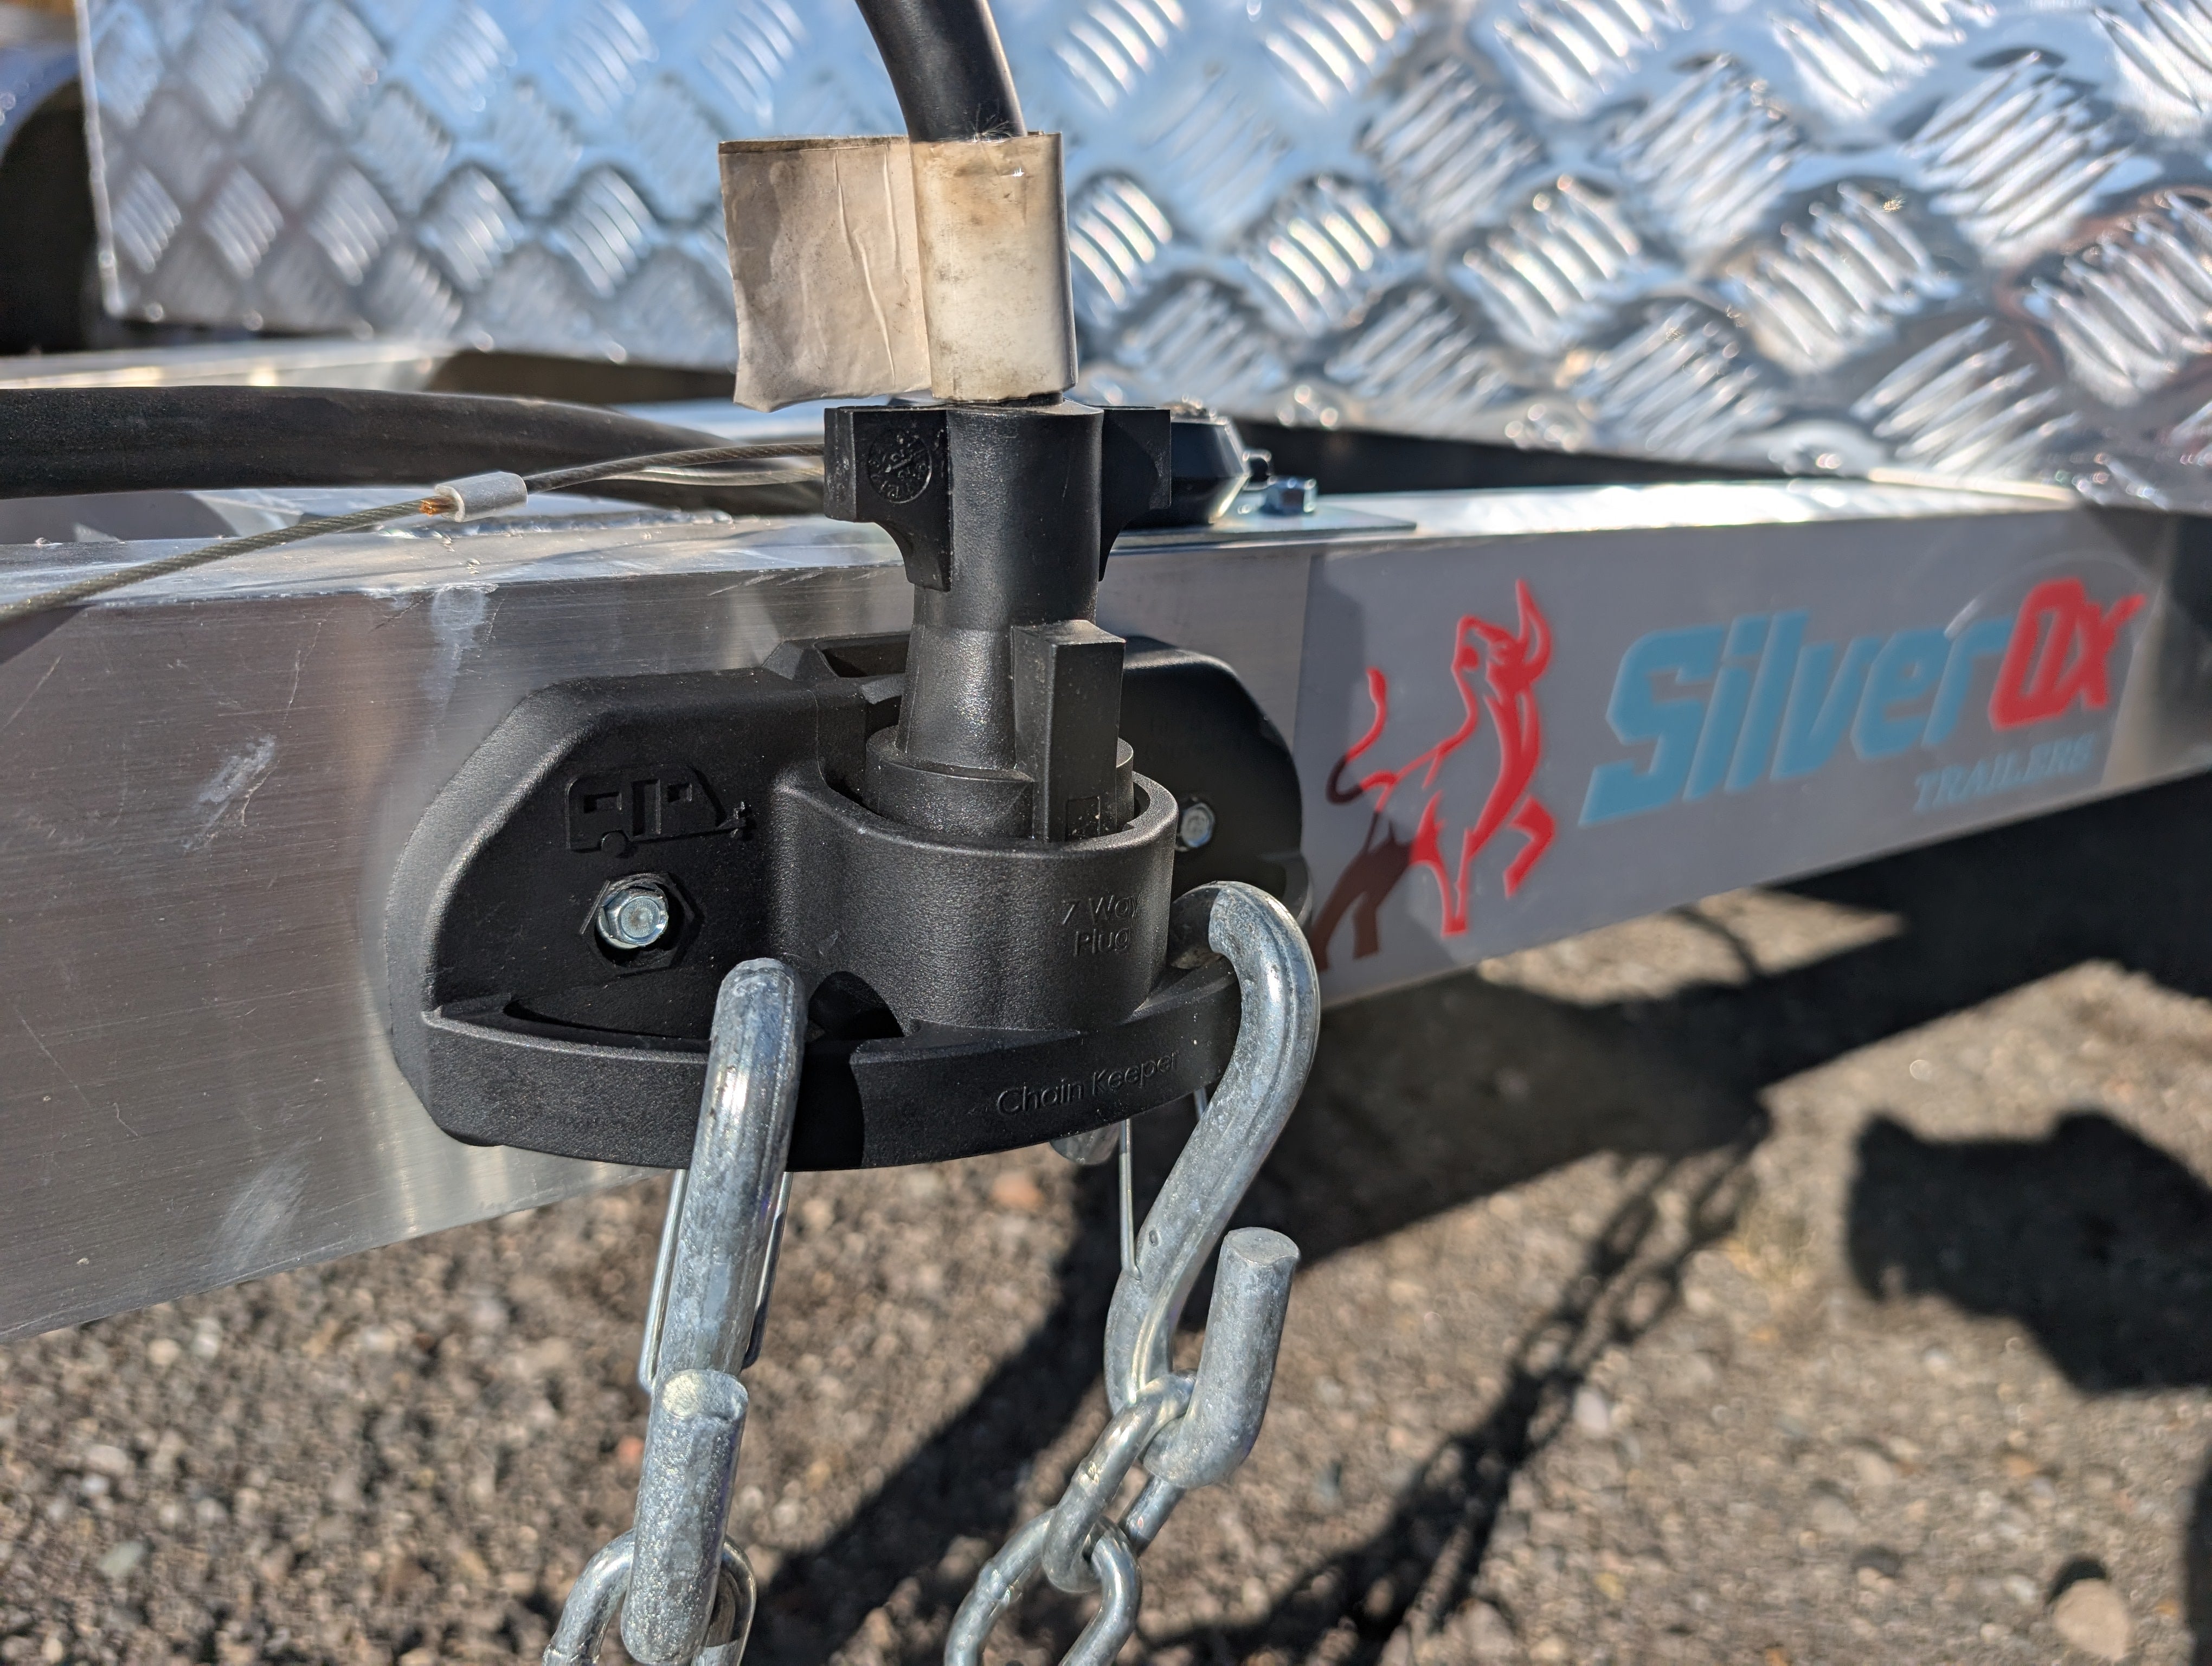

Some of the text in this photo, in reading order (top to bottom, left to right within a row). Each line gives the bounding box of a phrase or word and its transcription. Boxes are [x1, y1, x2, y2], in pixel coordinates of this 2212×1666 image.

[1913, 732, 2094, 812] TRAILERS
[1062, 892, 1142, 925] 7 Way
[996, 1050, 1179, 1116] Chain Keeper
